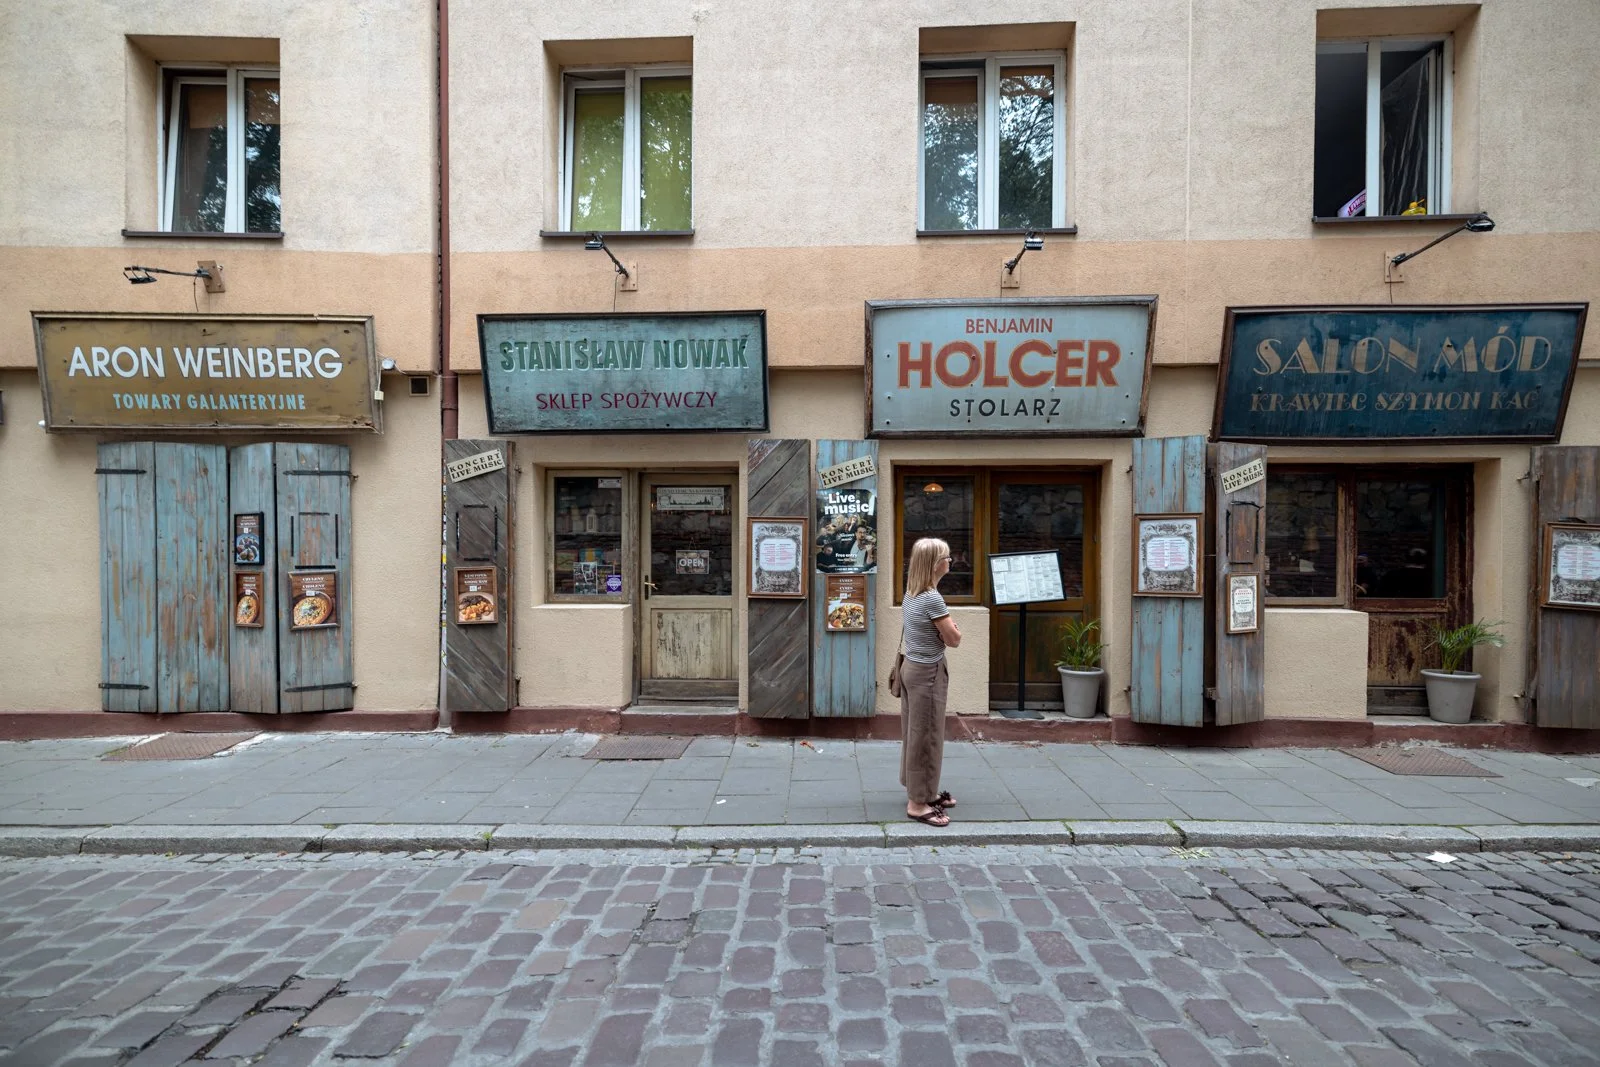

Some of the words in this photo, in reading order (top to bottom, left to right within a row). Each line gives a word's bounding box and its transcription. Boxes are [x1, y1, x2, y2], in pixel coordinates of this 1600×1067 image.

[965, 318, 1054, 334] BENJAMIN
[499, 340, 646, 372] STANISŁAW
[653, 338, 749, 371] NOWAK
[1252, 336, 1421, 376] SALON
[1432, 326, 1552, 374] MÓD
[68, 346, 166, 378] ARON
[173, 346, 344, 379] WEINBERG
[897, 338, 1121, 389] HOLCER
[113, 393, 182, 410] TOWARY
[187, 394, 306, 411] GALANTERYJNE
[536, 392, 593, 410] SKLEP
[601, 388, 718, 410] SPOŻYWCZY
[949, 398, 1061, 417] STOLARZ
[1250, 391, 1368, 412] KRAWIEC
[1374, 391, 1481, 412] SZYMON
[1491, 391, 1539, 411] KAC
[449, 452, 500, 473] KONCERT
[451, 468, 471, 480] LIVE
[473, 459, 503, 473] MUSIC
[821, 459, 872, 479] KONCERT
[1222, 462, 1262, 484] KONCERT
[823, 474, 844, 486] LIVE
[845, 465, 875, 479] MUSIC
[1224, 479, 1242, 491] LIVE
[1243, 470, 1264, 484] MUSIC
[824, 500, 870, 515] music
[828, 492, 856, 504] Live
[679, 558, 704, 567] OPEN
